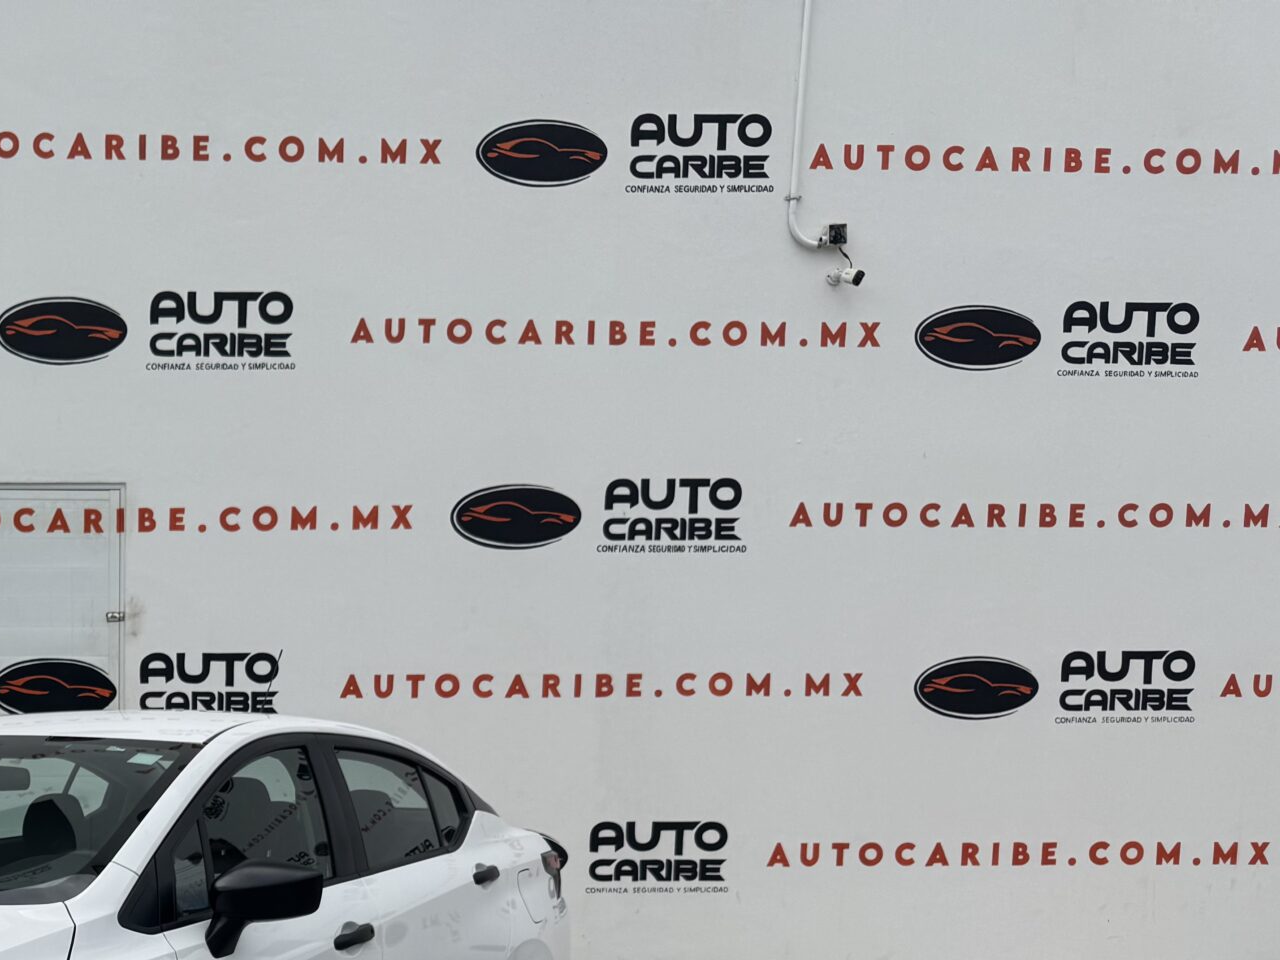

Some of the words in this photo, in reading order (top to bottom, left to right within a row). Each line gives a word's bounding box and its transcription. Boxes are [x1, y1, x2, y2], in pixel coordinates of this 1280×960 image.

[630, 112, 773, 152] AUTO
[629, 153, 770, 181] CARIBE
[624, 185, 671, 194] CONFIANZA
[674, 184, 718, 194] SEGURIDAD
[726, 184, 775, 193] SIMPLICIDAD
[149, 290, 294, 329] AUTO
[1062, 300, 1200, 338] AUTO
[149, 331, 293, 359] CARIBE
[351, 317, 880, 349] AUTOCARIBE.COM.MX
[145, 360, 192, 371] CONFIANZA
[195, 361, 239, 371] SEGURIDAD
[247, 362, 296, 370] SIMPLICIDAD
[1060, 340, 1197, 367] CARIBE
[1056, 367, 1101, 376] CONFIANZA
[1104, 368, 1145, 377] SEGURIDAD
[1154, 369, 1199, 378] SIMPLICIDAD
[603, 477, 743, 515] AUTO
[602, 516, 742, 542] CARIBE
[790, 502, 1280, 529] AUTOCARIBE.COM.M
[139, 652, 280, 687] AUTO
[1060, 649, 1196, 685] AUTO
[340, 671, 863, 700] AUTOCARIBE.COM.MX
[1058, 687, 1195, 712] CARIBE
[139, 691, 280, 714] CARIBE
[1054, 716, 1098, 724] CONFIANZA
[1101, 716, 1142, 724] SEGURIDAD
[588, 820, 729, 857] AUTO
[767, 840, 1270, 868] AUTOCARIBE.COM.MX
[588, 858, 727, 883] CARIBE
[632, 886, 674, 894] SEGURIDAD
